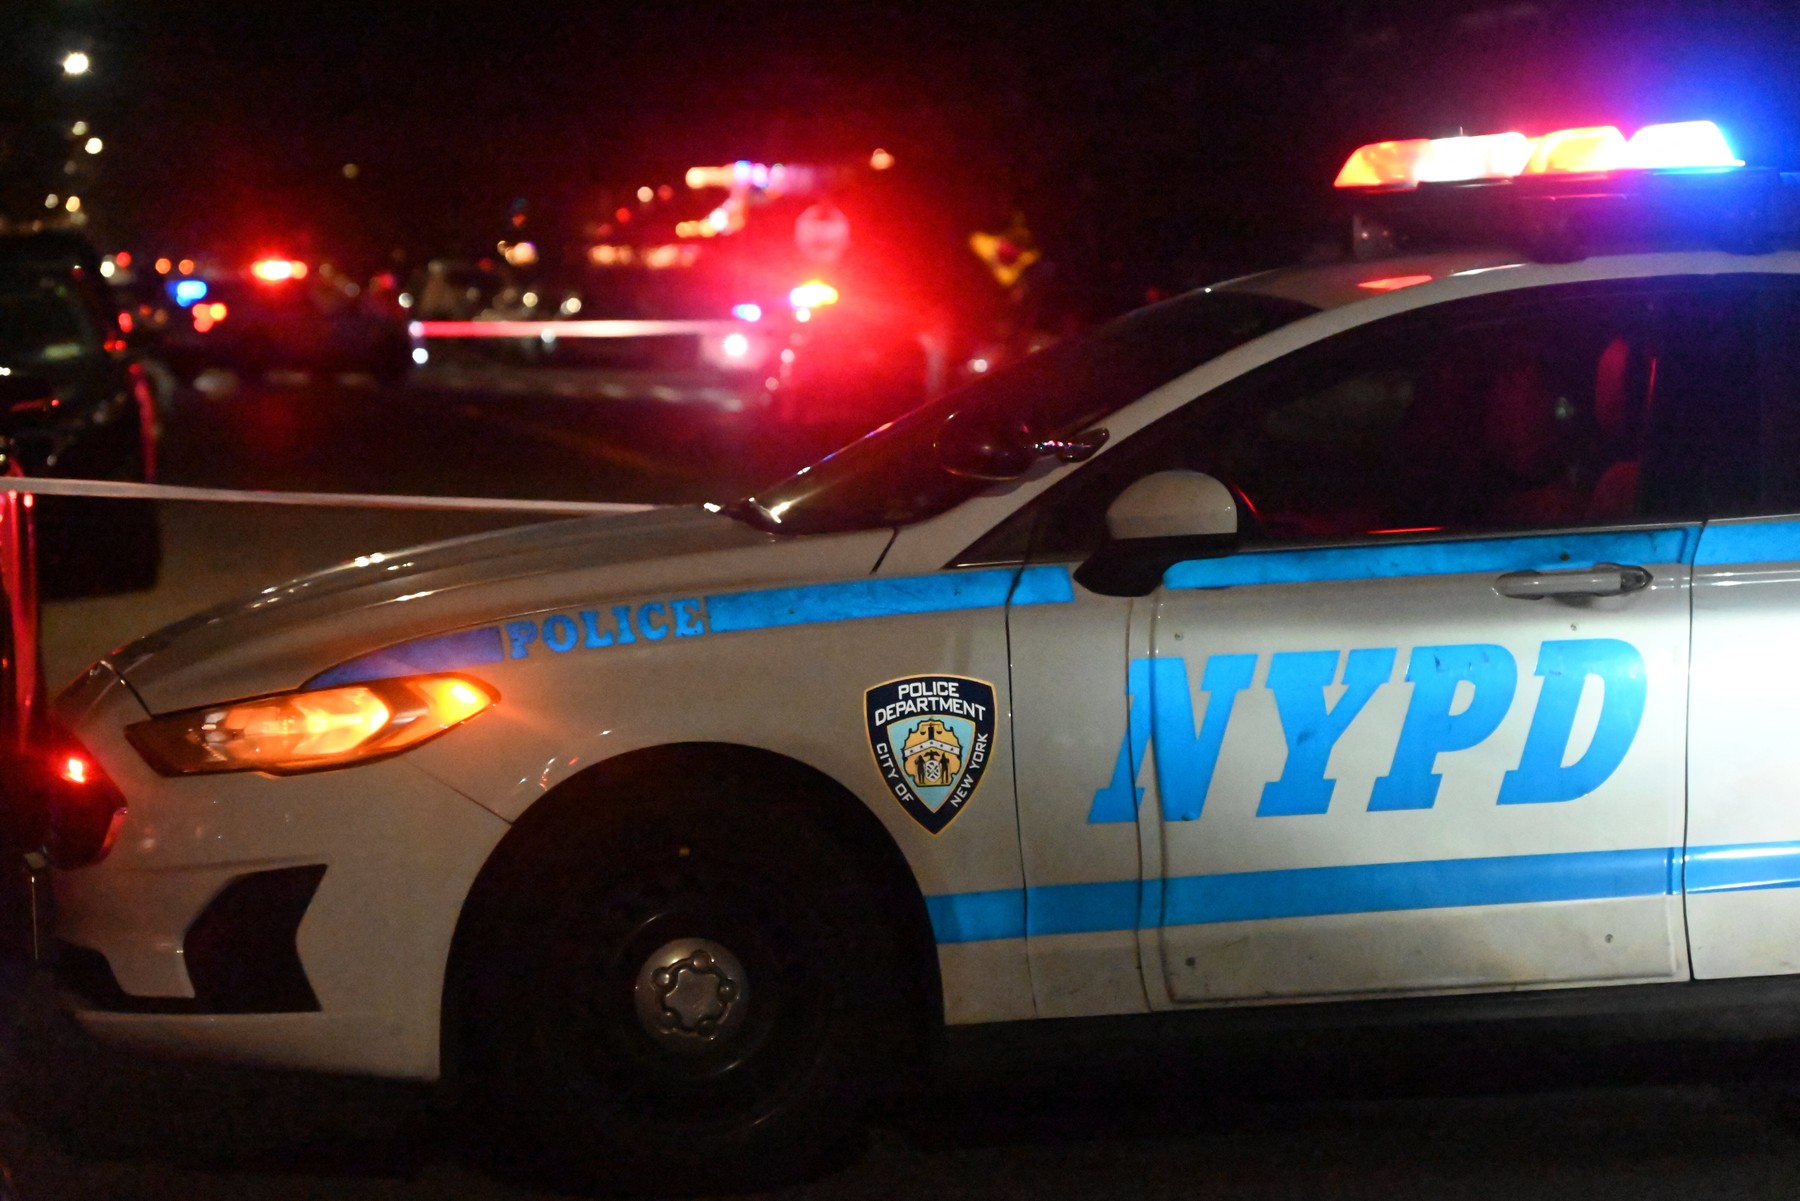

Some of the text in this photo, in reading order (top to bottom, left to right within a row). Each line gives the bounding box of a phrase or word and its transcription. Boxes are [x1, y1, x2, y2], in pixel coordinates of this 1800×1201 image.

[504, 599, 705, 659] POLICE
[874, 697, 986, 726] DEPARTMENT
[898, 681, 960, 699] POLICE
[1087, 638, 1648, 824] NYPD
[877, 742, 914, 802] CITY OF
[950, 733, 988, 807] NEW YORK
